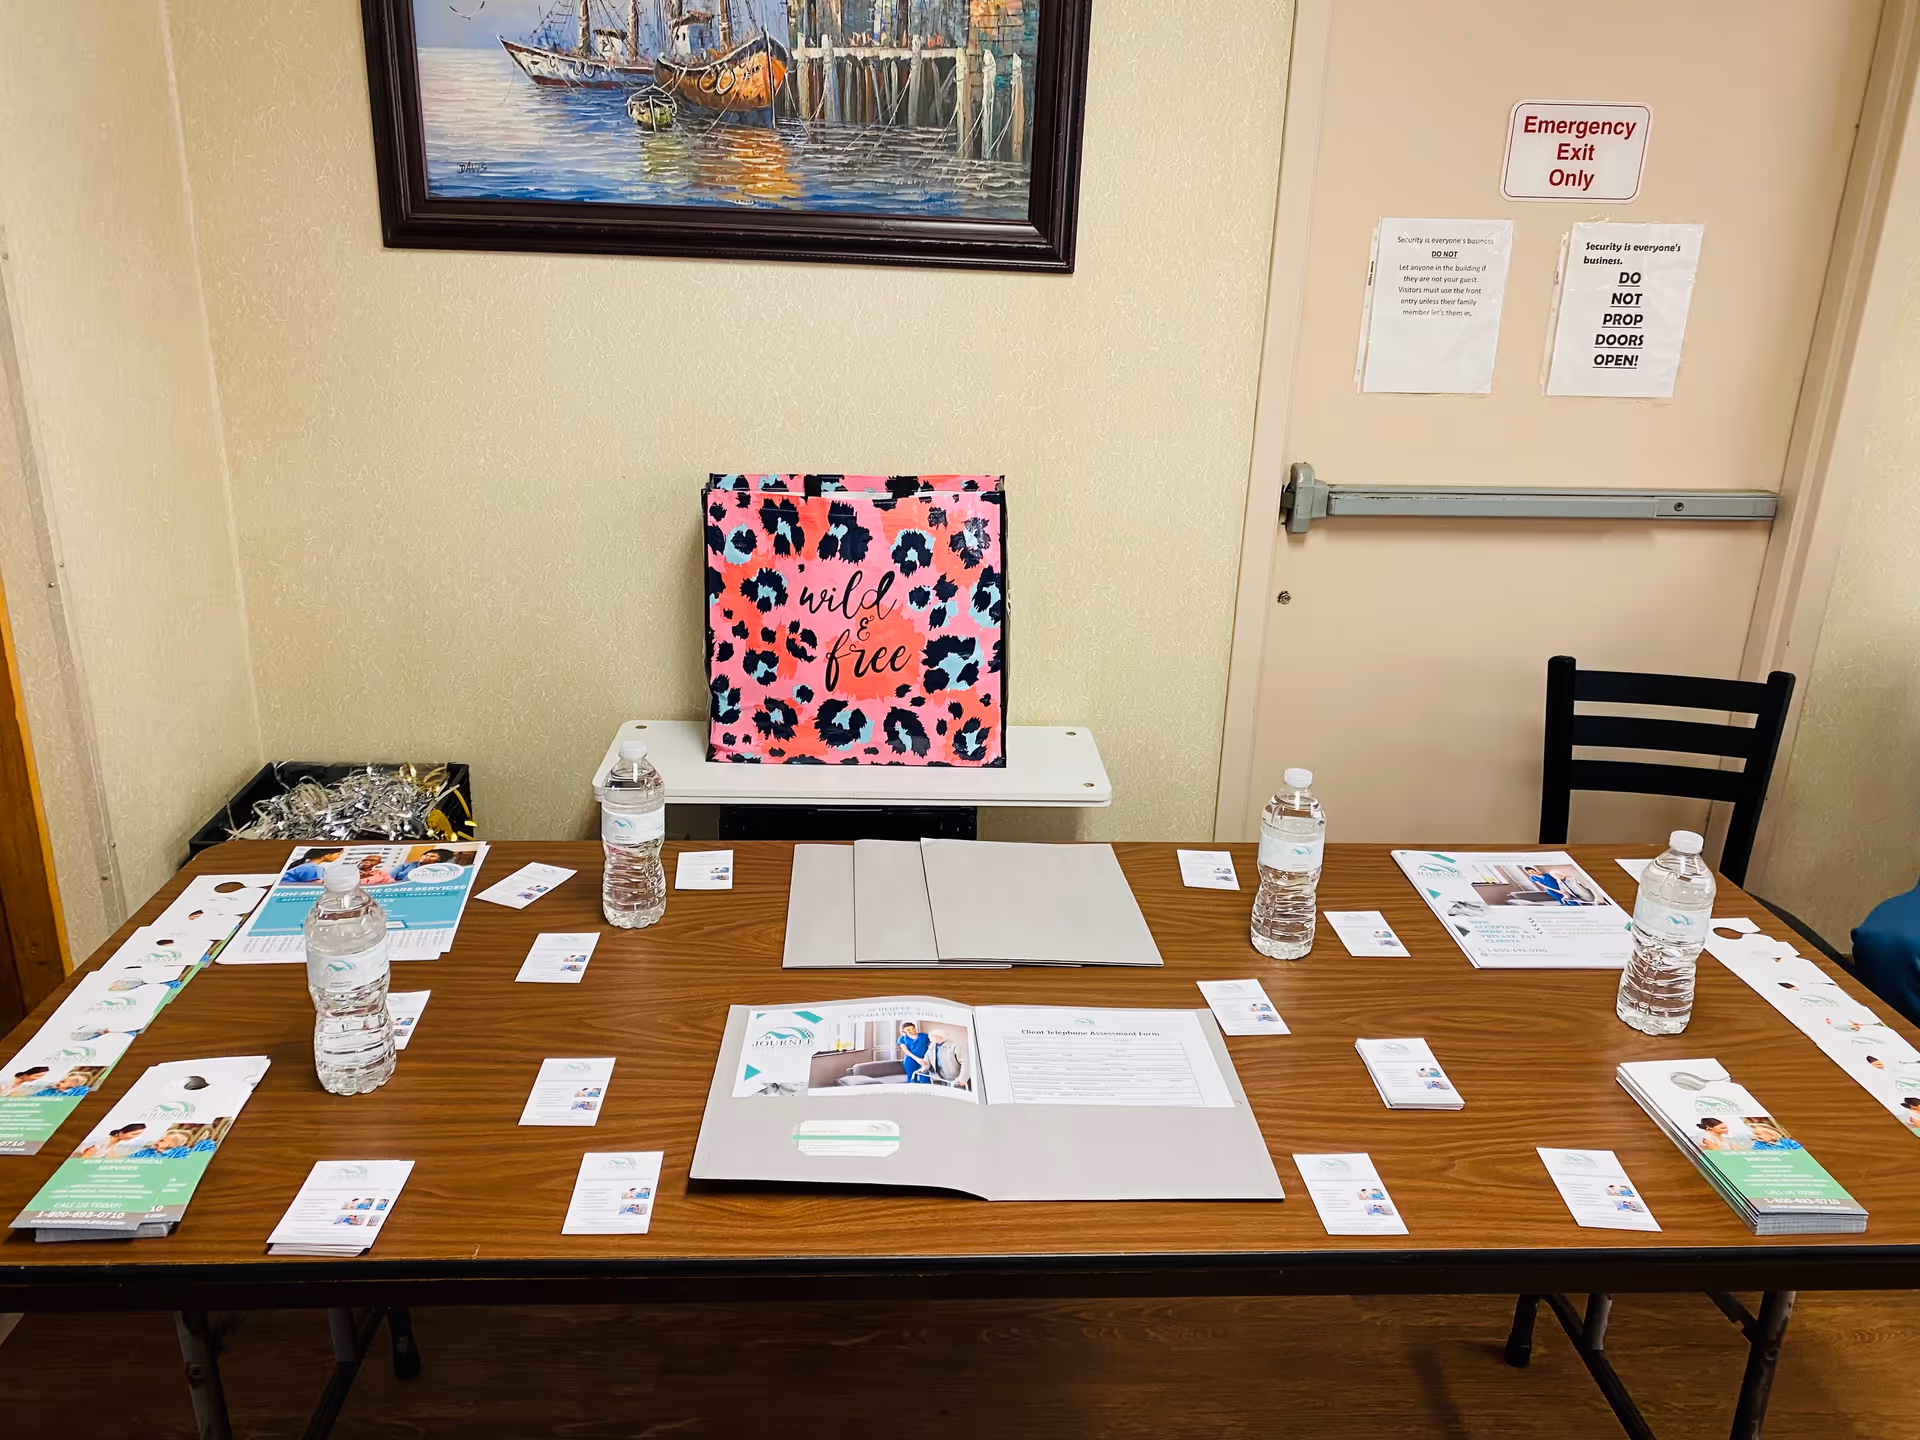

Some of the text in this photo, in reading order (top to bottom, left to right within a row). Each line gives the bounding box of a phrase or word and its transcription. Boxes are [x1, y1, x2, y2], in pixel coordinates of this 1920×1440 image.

[1523, 116, 1637, 140] Emergency
[1557, 143, 1595, 161] Exit
[1549, 169, 1595, 191] Only
[1398, 236, 1423, 244] Security
[1431, 237, 1466, 245] everyone's
[1586, 242, 1681, 253] Security is everyone's
[1583, 256, 1623, 265] business.
[1455, 265, 1481, 273] building
[1619, 272, 1641, 284] DO
[1398, 286, 1422, 294] Visitors
[1457, 299, 1477, 307] family
[1611, 293, 1643, 305] NOT
[1602, 314, 1644, 325] PROP
[1595, 334, 1644, 346] DOORS
[1593, 354, 1639, 366] OPEN!
[799, 570, 897, 620] wild
[857, 615, 874, 641] &
[825, 628, 912, 692] free
[752, 1039, 814, 1047] JOURNEE
[36, 1211, 125, 1219] 1-800-693-0710
